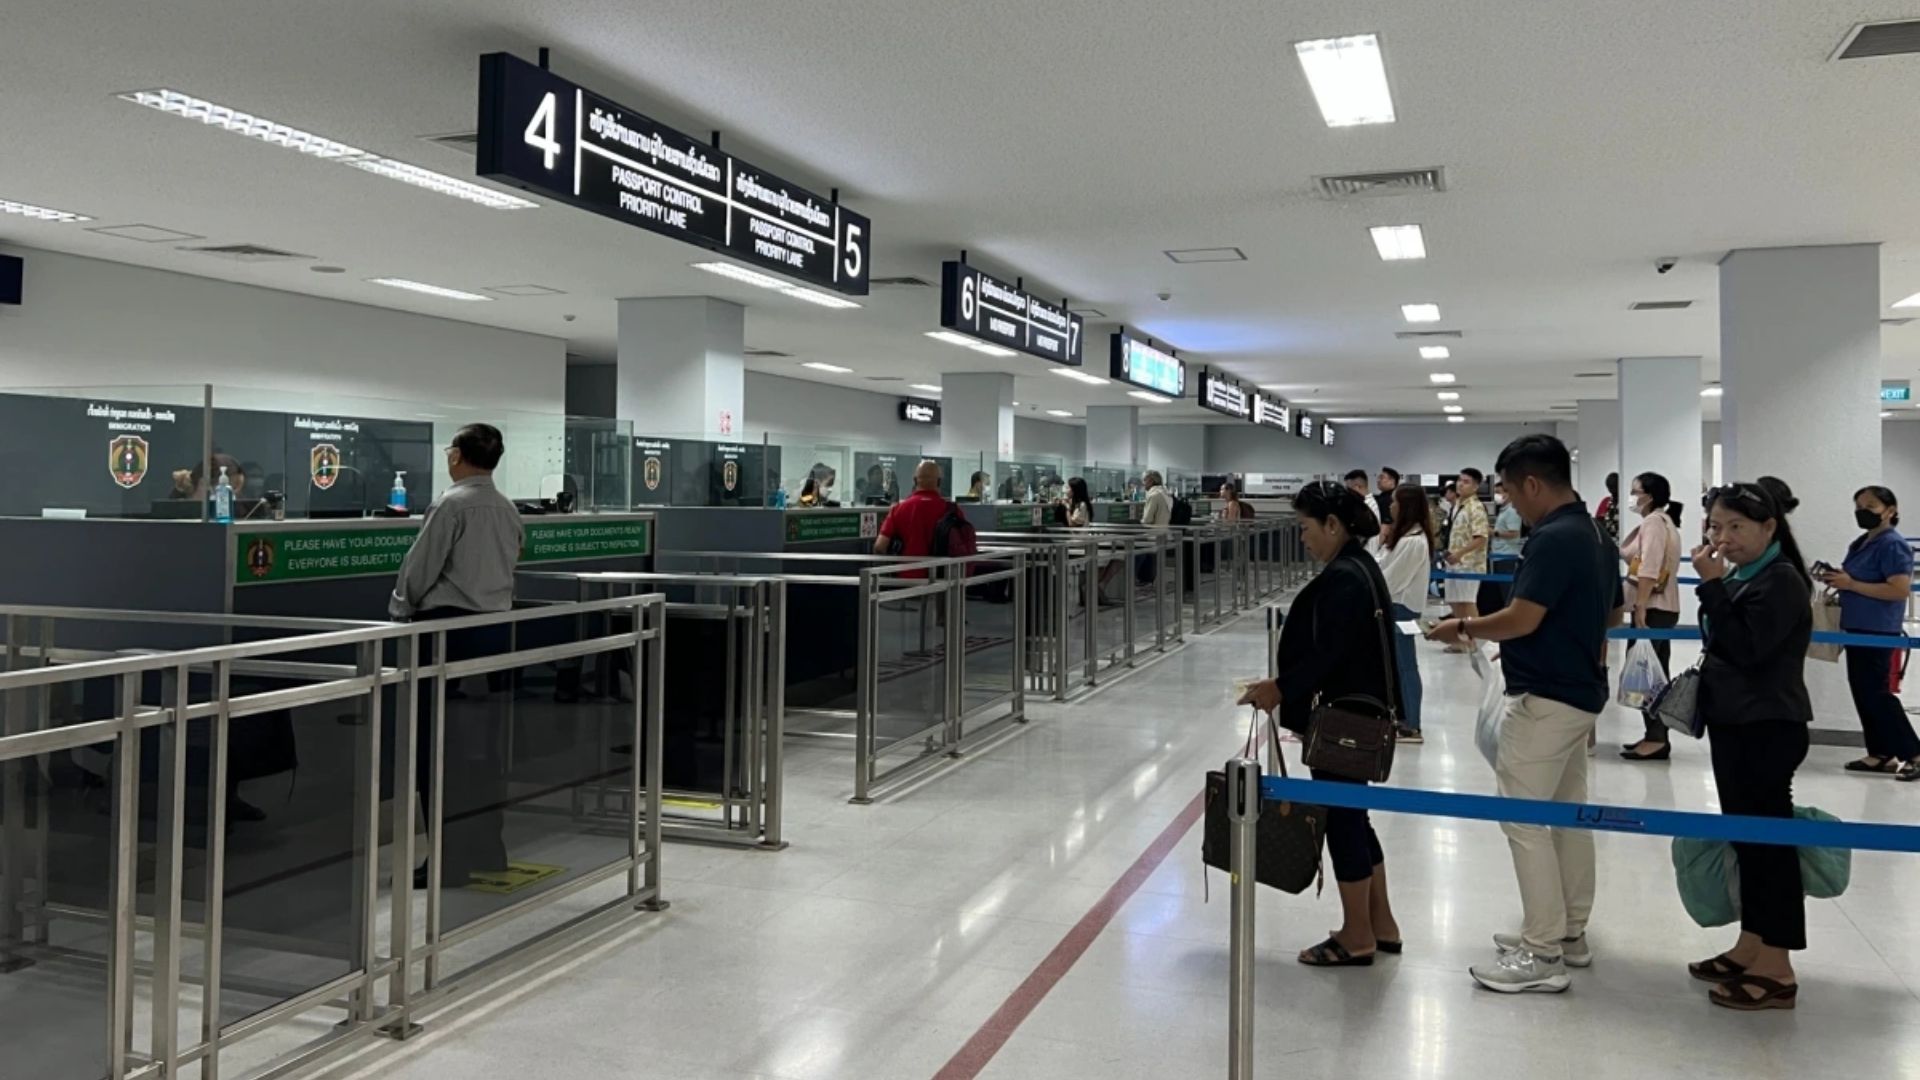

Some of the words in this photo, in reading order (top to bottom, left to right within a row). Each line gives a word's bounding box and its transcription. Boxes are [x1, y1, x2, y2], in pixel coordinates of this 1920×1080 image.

[524, 91, 561, 170] 4
[612, 165, 663, 198] PASSPORT
[663, 185, 704, 214] CONTROL
[620, 191, 663, 220] PRIORITY
[664, 207, 687, 229] LANE
[750, 217, 787, 244] PASSPORT
[786, 230, 816, 255] CONTROL
[755, 238, 786, 262] PRIORITY
[787, 250, 804, 268] LANE
[844, 223, 861, 278] 5
[961, 276, 974, 320] 6
[1070, 321, 1080, 356] 7
[1123, 342, 1129, 373] 8
[284, 539, 320, 551] PLEASE
[322, 538, 347, 549] HAVE
[349, 537, 373, 548] YOUR
[374, 535, 416, 547] DOCUMEN
[532, 529, 555, 539] PLEASE
[573, 528, 590, 537] YOUR
[288, 556, 338, 570] EVERYONE
[340, 555, 349, 566] IS
[351, 554, 388, 566] SUBJECT
[390, 553, 401, 563] TO
